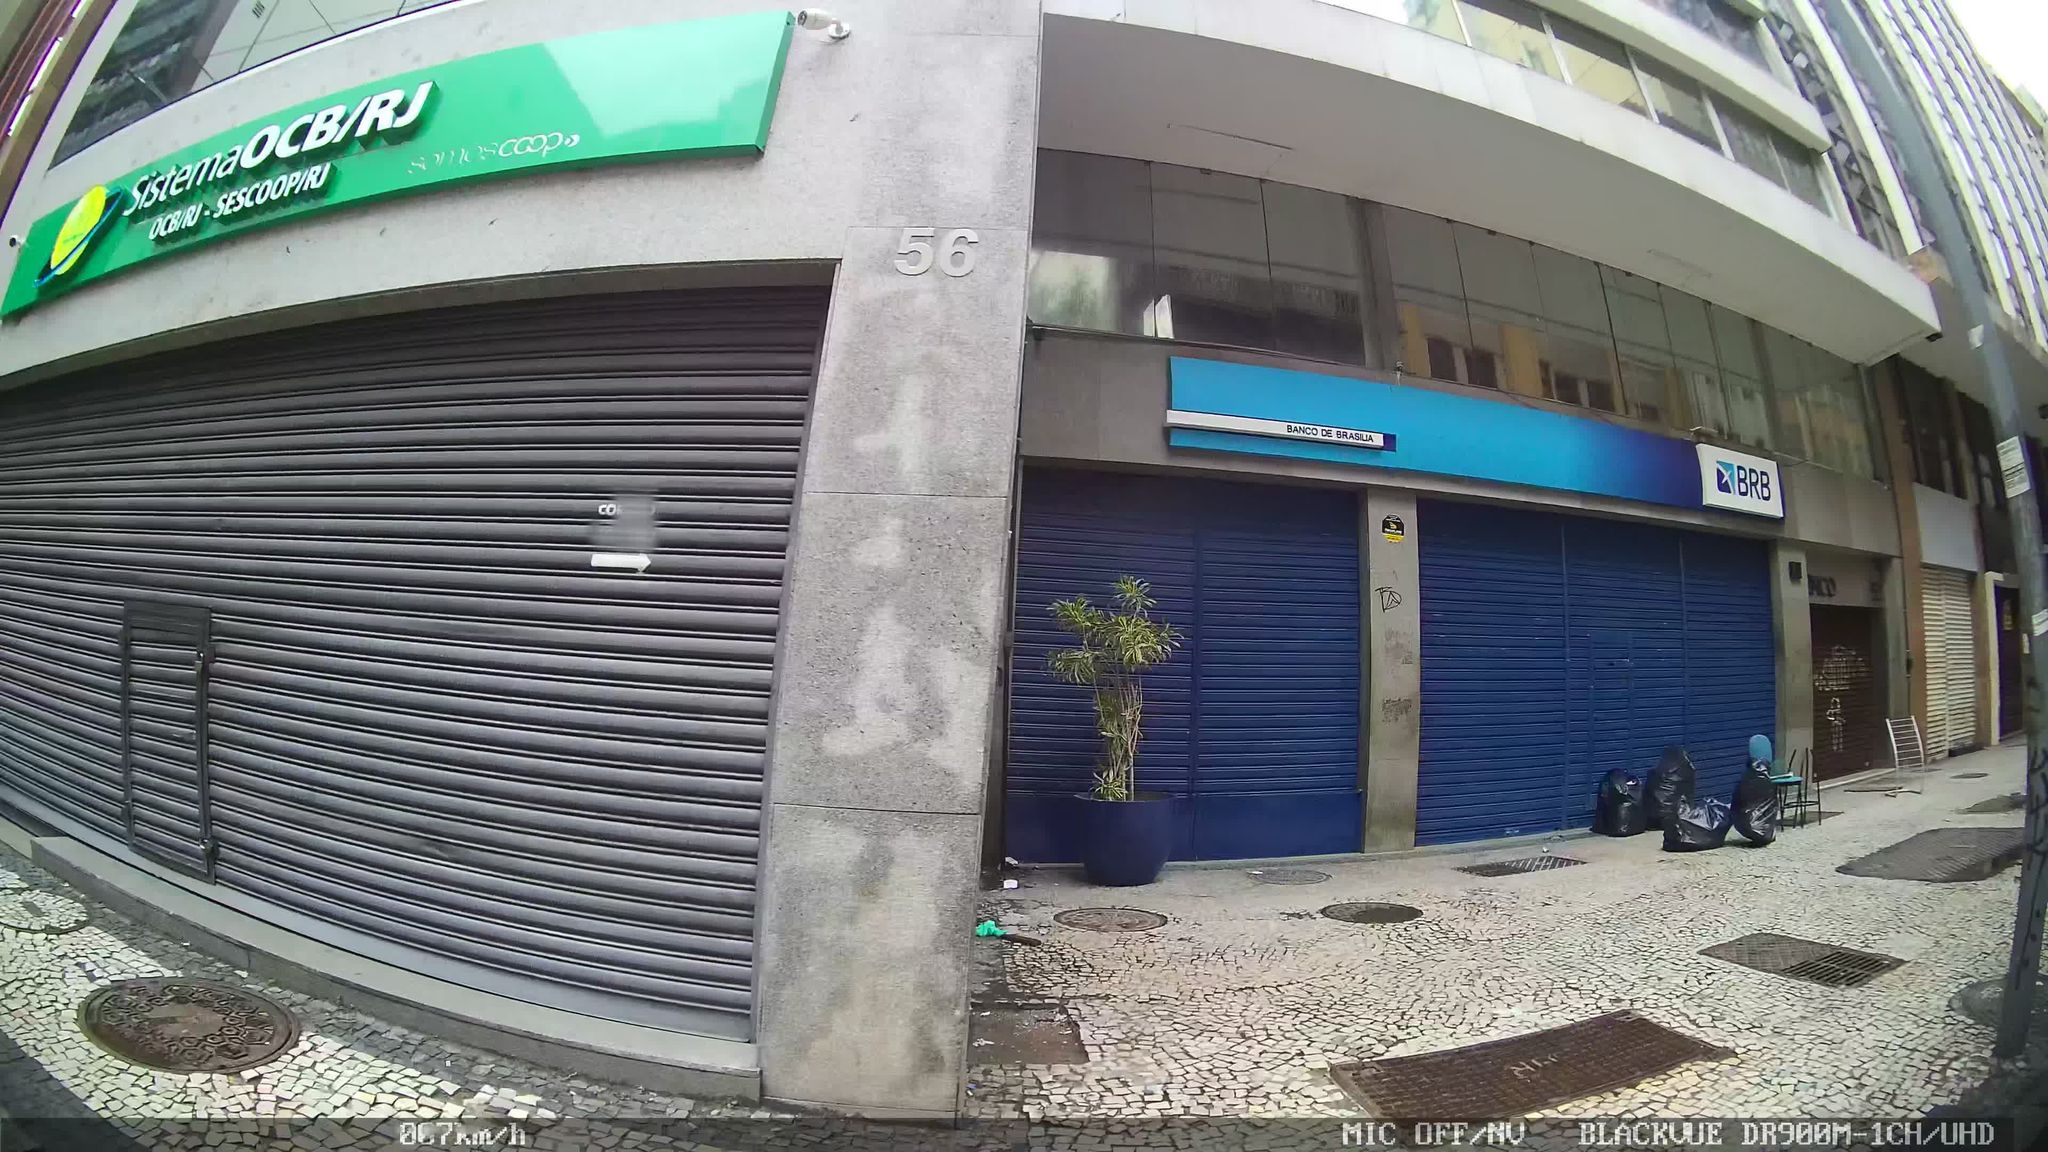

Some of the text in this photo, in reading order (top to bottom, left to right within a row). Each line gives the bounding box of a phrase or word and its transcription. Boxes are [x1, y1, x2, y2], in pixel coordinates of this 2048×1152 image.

[147, 201, 204, 241] OCB/RJ
[212, 162, 332, 220] SESCOOP/RJ
[893, 227, 980, 278] 56
[1286, 424, 1319, 436] BANCO
[1321, 428, 1333, 438] DE
[1736, 465, 1772, 502] BRB
